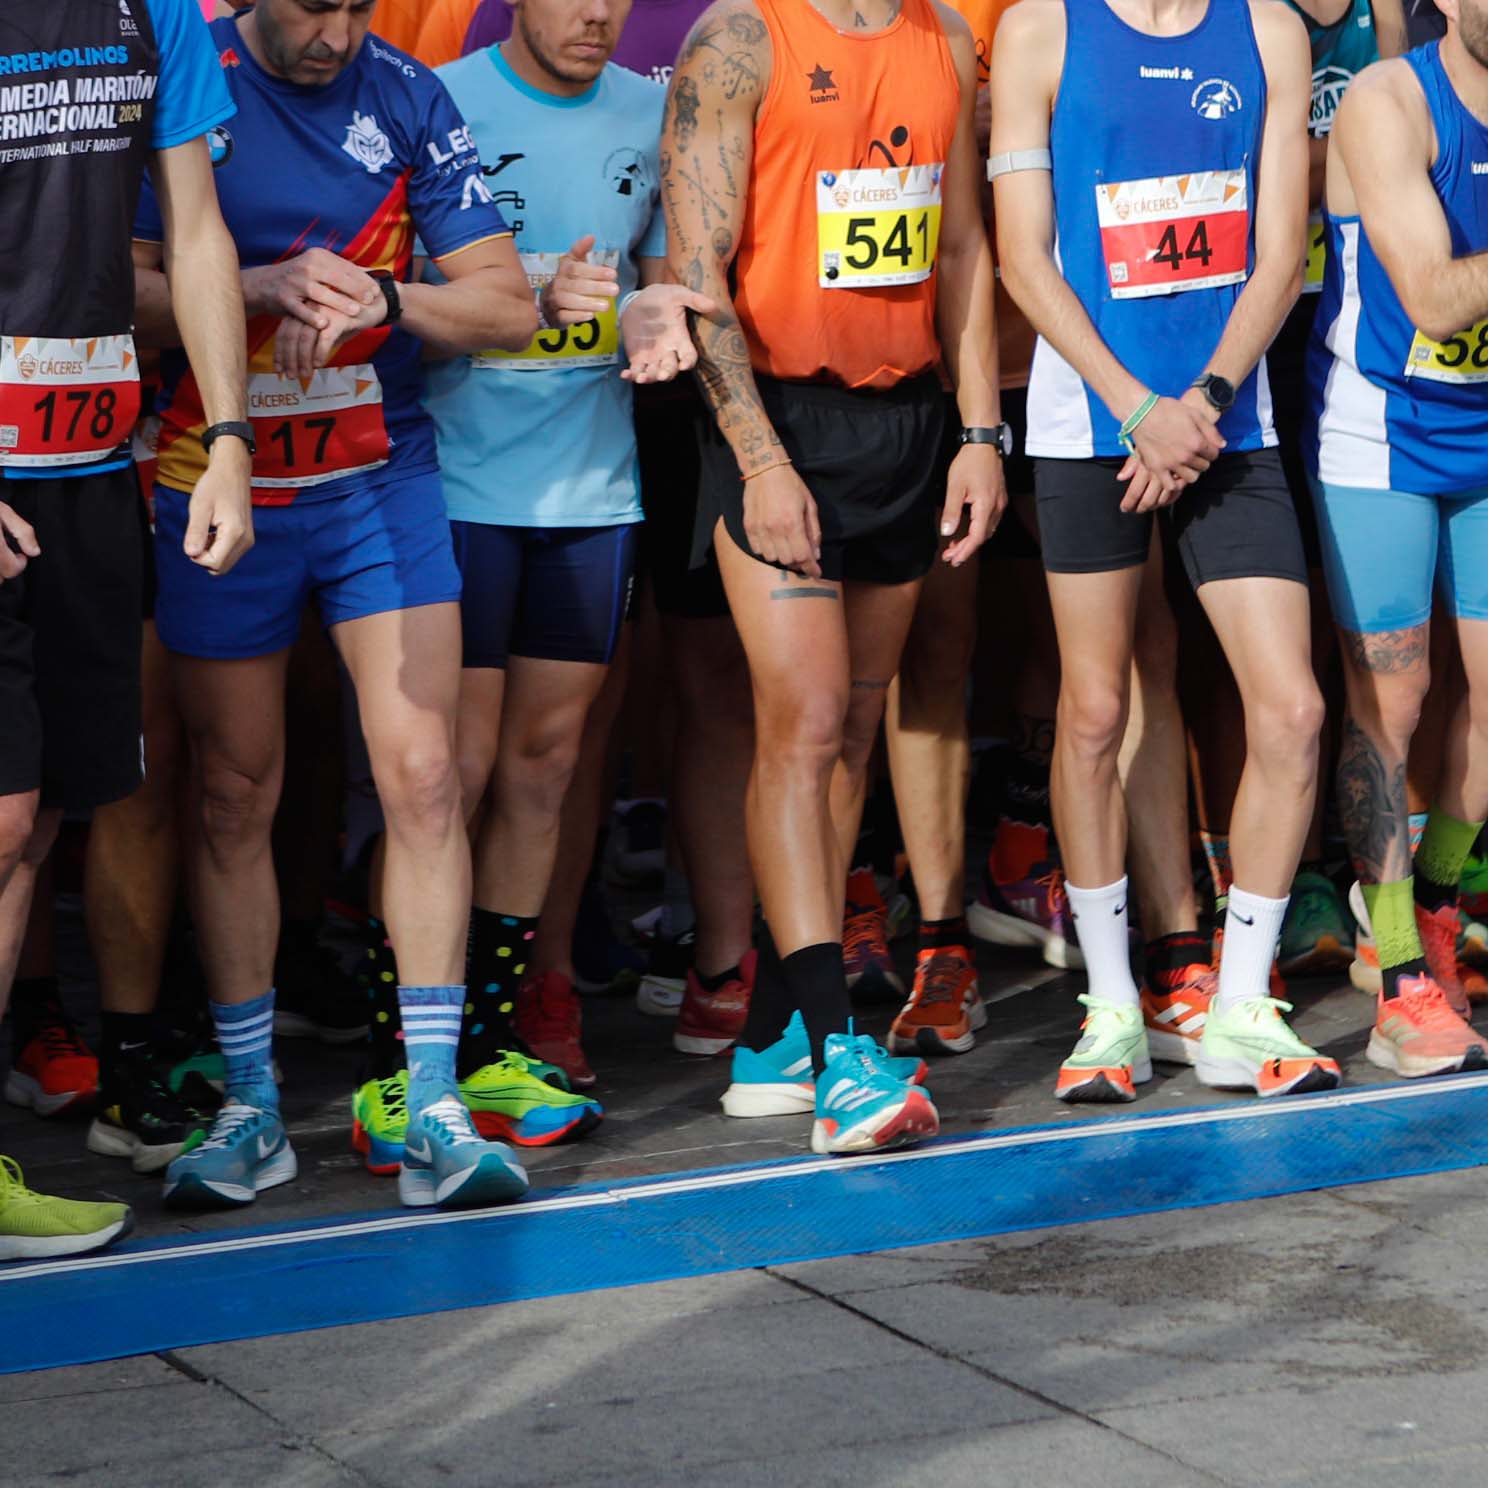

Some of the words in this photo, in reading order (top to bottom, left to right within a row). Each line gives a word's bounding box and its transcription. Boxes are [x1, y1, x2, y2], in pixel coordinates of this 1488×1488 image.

[1140, 65, 1179, 79] luanvi
[1, 78, 71, 113] MEDIA
[75, 69, 159, 104] MARATÓN
[810, 93, 840, 104] luanvi
[118, 103, 144, 123] 2024
[70, 139, 92, 155] HALF
[853, 189, 898, 204] CÁCERES
[1133, 197, 1179, 214] CÁCERES
[845, 211, 929, 270] 541
[1153, 220, 1213, 271] 44
[39, 357, 83, 376] CÁCERES
[250, 391, 300, 408] CÁCERES
[34, 388, 116, 443] 178
[271, 416, 337, 467] 17
